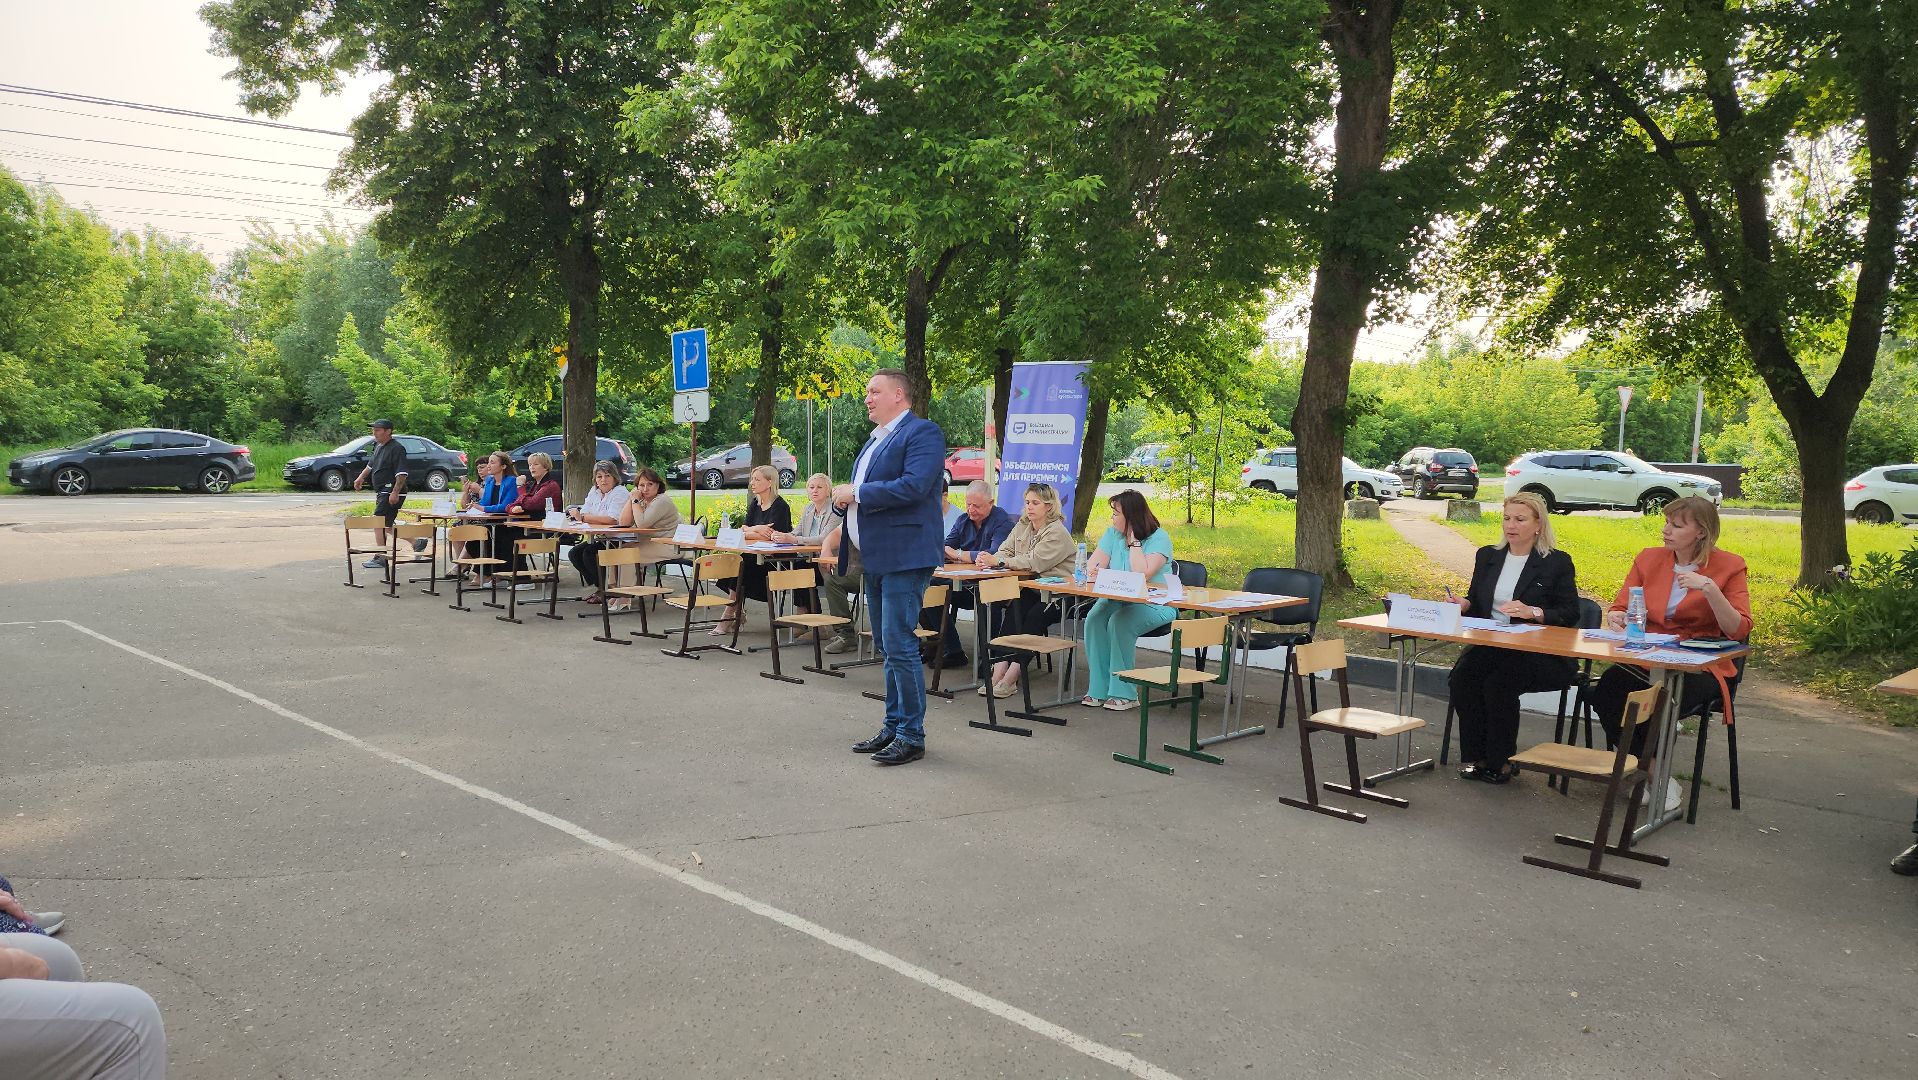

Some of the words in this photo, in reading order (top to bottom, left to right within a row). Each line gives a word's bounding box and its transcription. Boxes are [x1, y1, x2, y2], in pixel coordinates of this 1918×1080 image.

[1004, 461, 1070, 472] ОБЪЕДИНЯЕМСЯ
[1003, 472, 1020, 481] ДЛЯ
[1021, 473, 1059, 483] ПЕРЕМЕН
